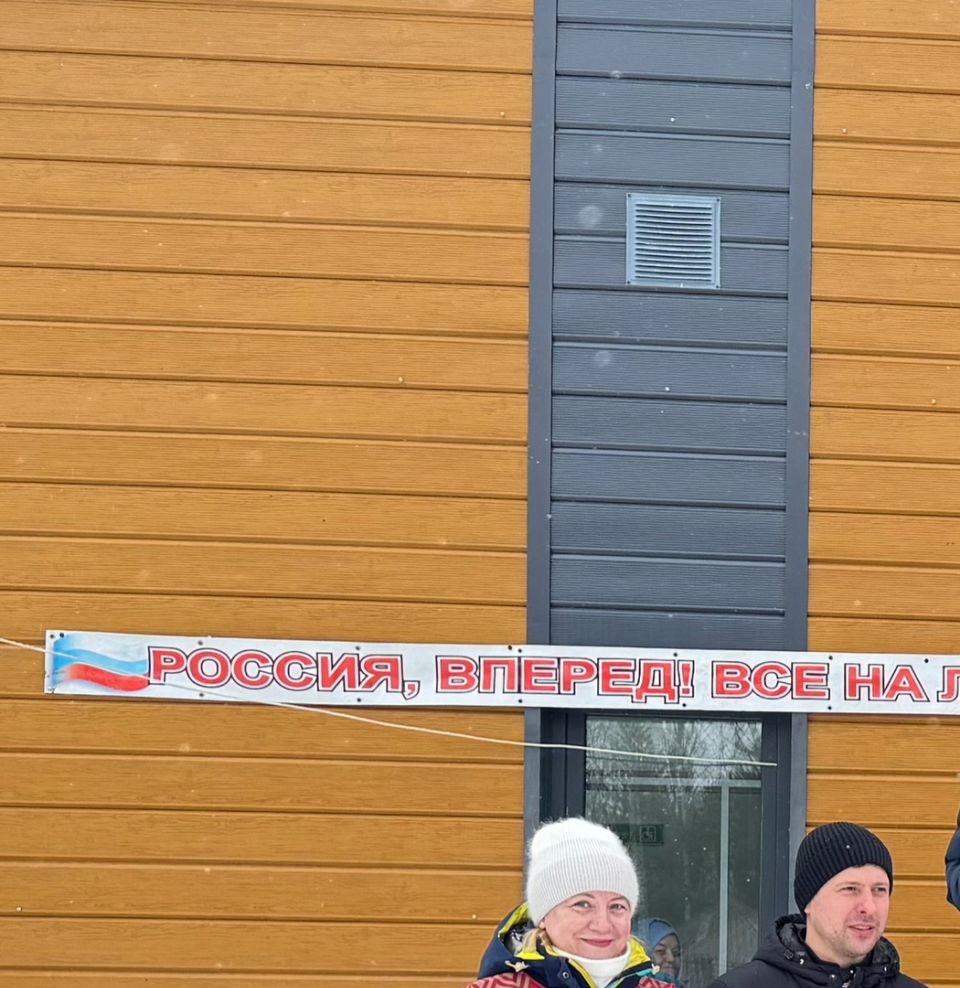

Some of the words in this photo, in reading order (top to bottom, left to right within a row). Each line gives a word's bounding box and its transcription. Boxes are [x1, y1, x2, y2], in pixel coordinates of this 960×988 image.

[147, 646, 421, 700] РОССИЯ,
[435, 655, 694, 704] ВПЕРЕД!
[711, 659, 830, 701] ВСЕ
[843, 662, 931, 703] НА
